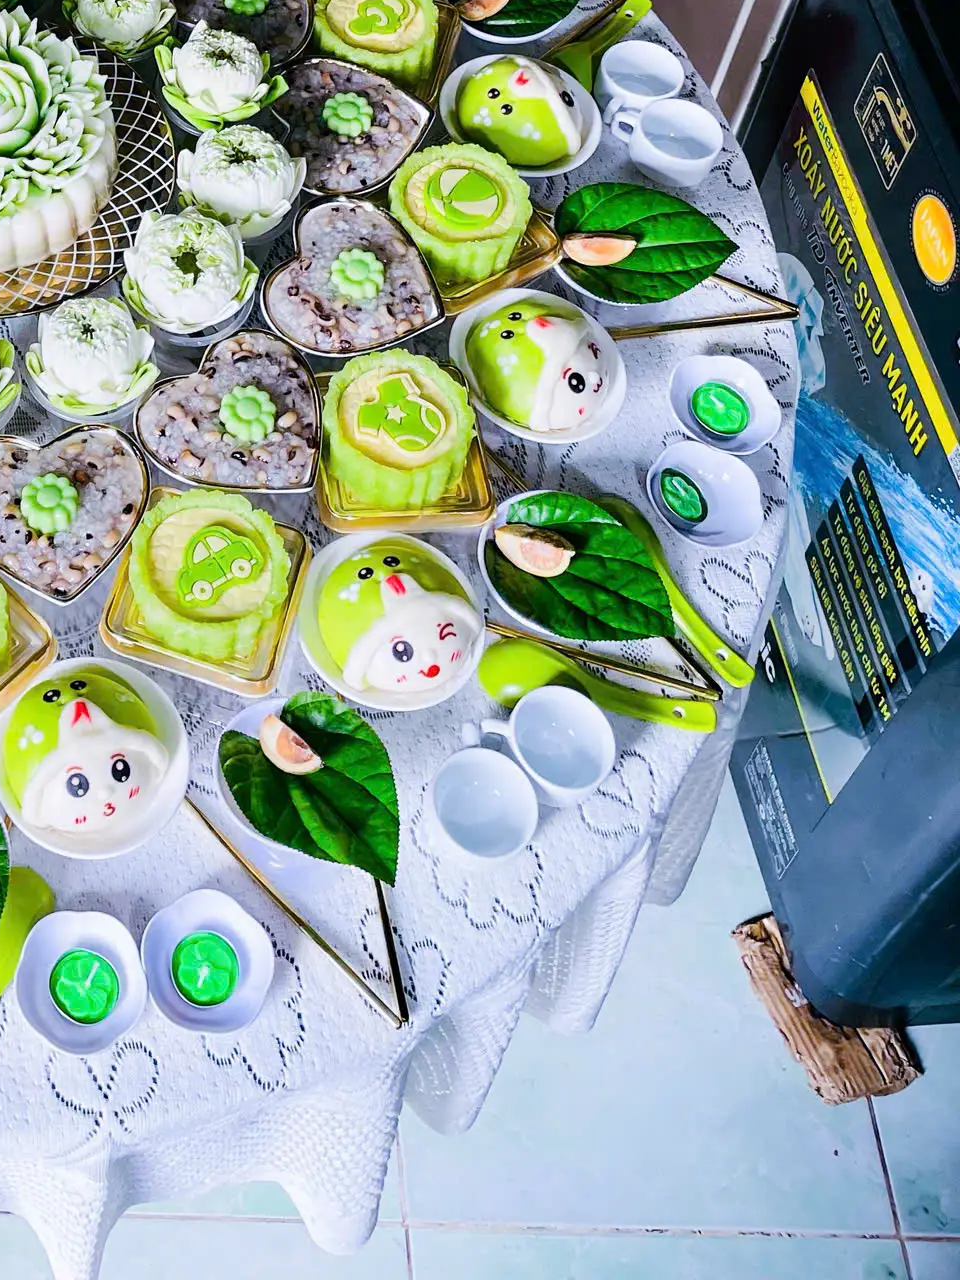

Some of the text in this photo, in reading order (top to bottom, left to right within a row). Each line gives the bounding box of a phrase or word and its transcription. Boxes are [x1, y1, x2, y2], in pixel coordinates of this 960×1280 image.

[793, 126, 928, 457] XOÁY NƯỚC SIÊU MẠNH
[806, 223, 826, 265] TD
[825, 275, 870, 385] INVERTER
[834, 513, 843, 535] Tự
[840, 535, 855, 572] động
[859, 588, 873, 620] sinh
[880, 653, 897, 683] giặt
[846, 492, 856, 514] Tự
[854, 516, 869, 555] động
[858, 470, 872, 500] Giặt
[868, 500, 883, 530] siêu
[894, 566, 908, 595] bọt
[903, 593, 919, 626] siêu
[916, 626, 931, 657] mịn
[878, 696, 891, 722] 1M
